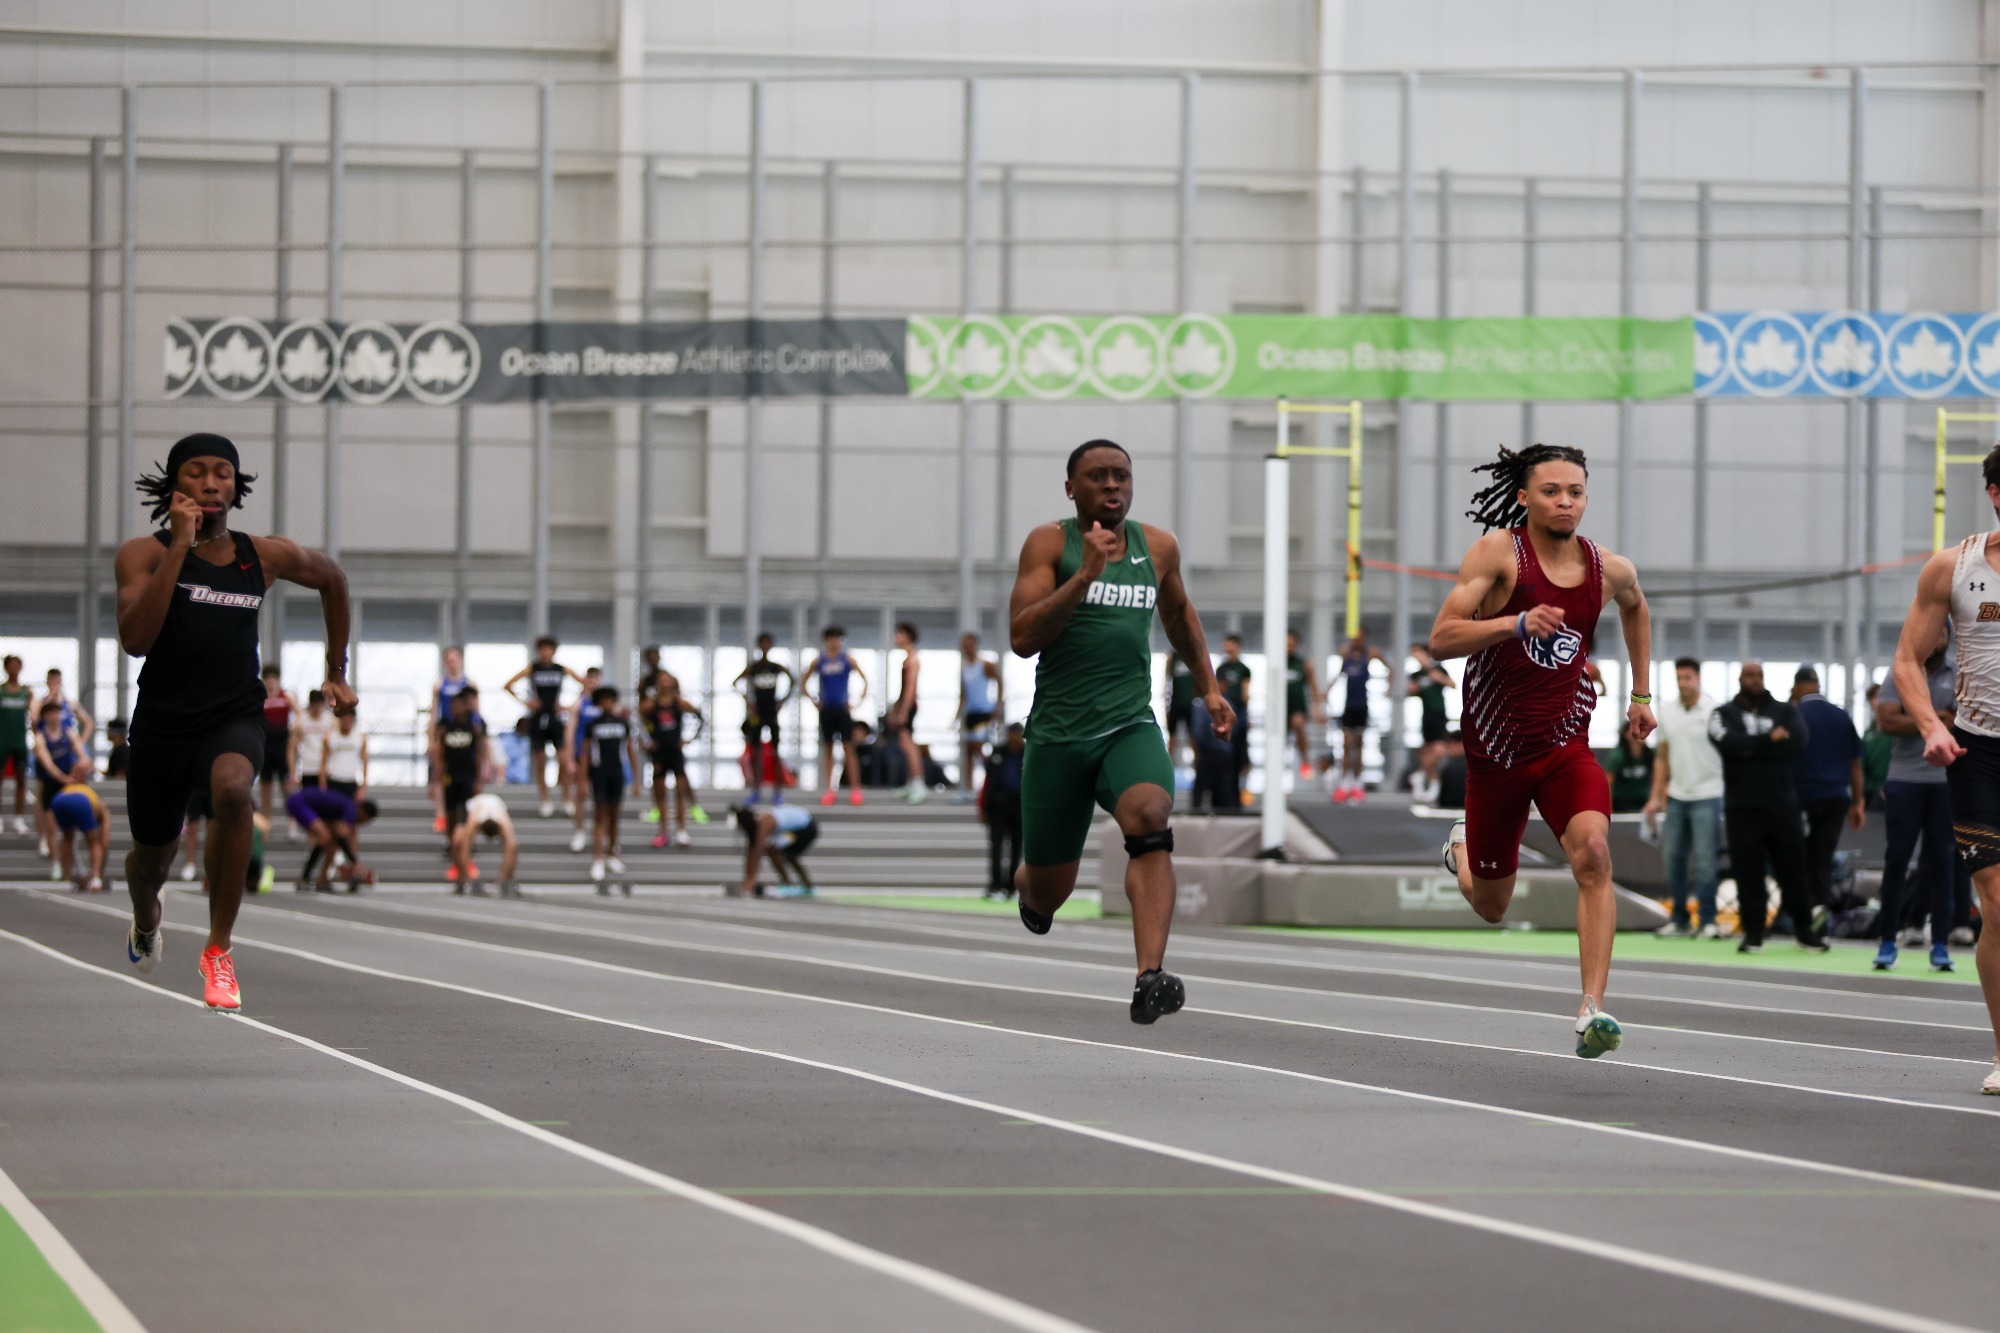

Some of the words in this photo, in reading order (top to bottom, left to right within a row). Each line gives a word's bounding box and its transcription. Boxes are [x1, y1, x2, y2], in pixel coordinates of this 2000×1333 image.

[500, 346, 580, 377] Ocean
[583, 345, 679, 376] Breeze
[680, 343, 775, 374] Athletic
[776, 342, 894, 377] Complex
[1257, 341, 1349, 372] Ocean
[1352, 340, 1446, 373] Breeze
[1084, 581, 1156, 609] AGNER
